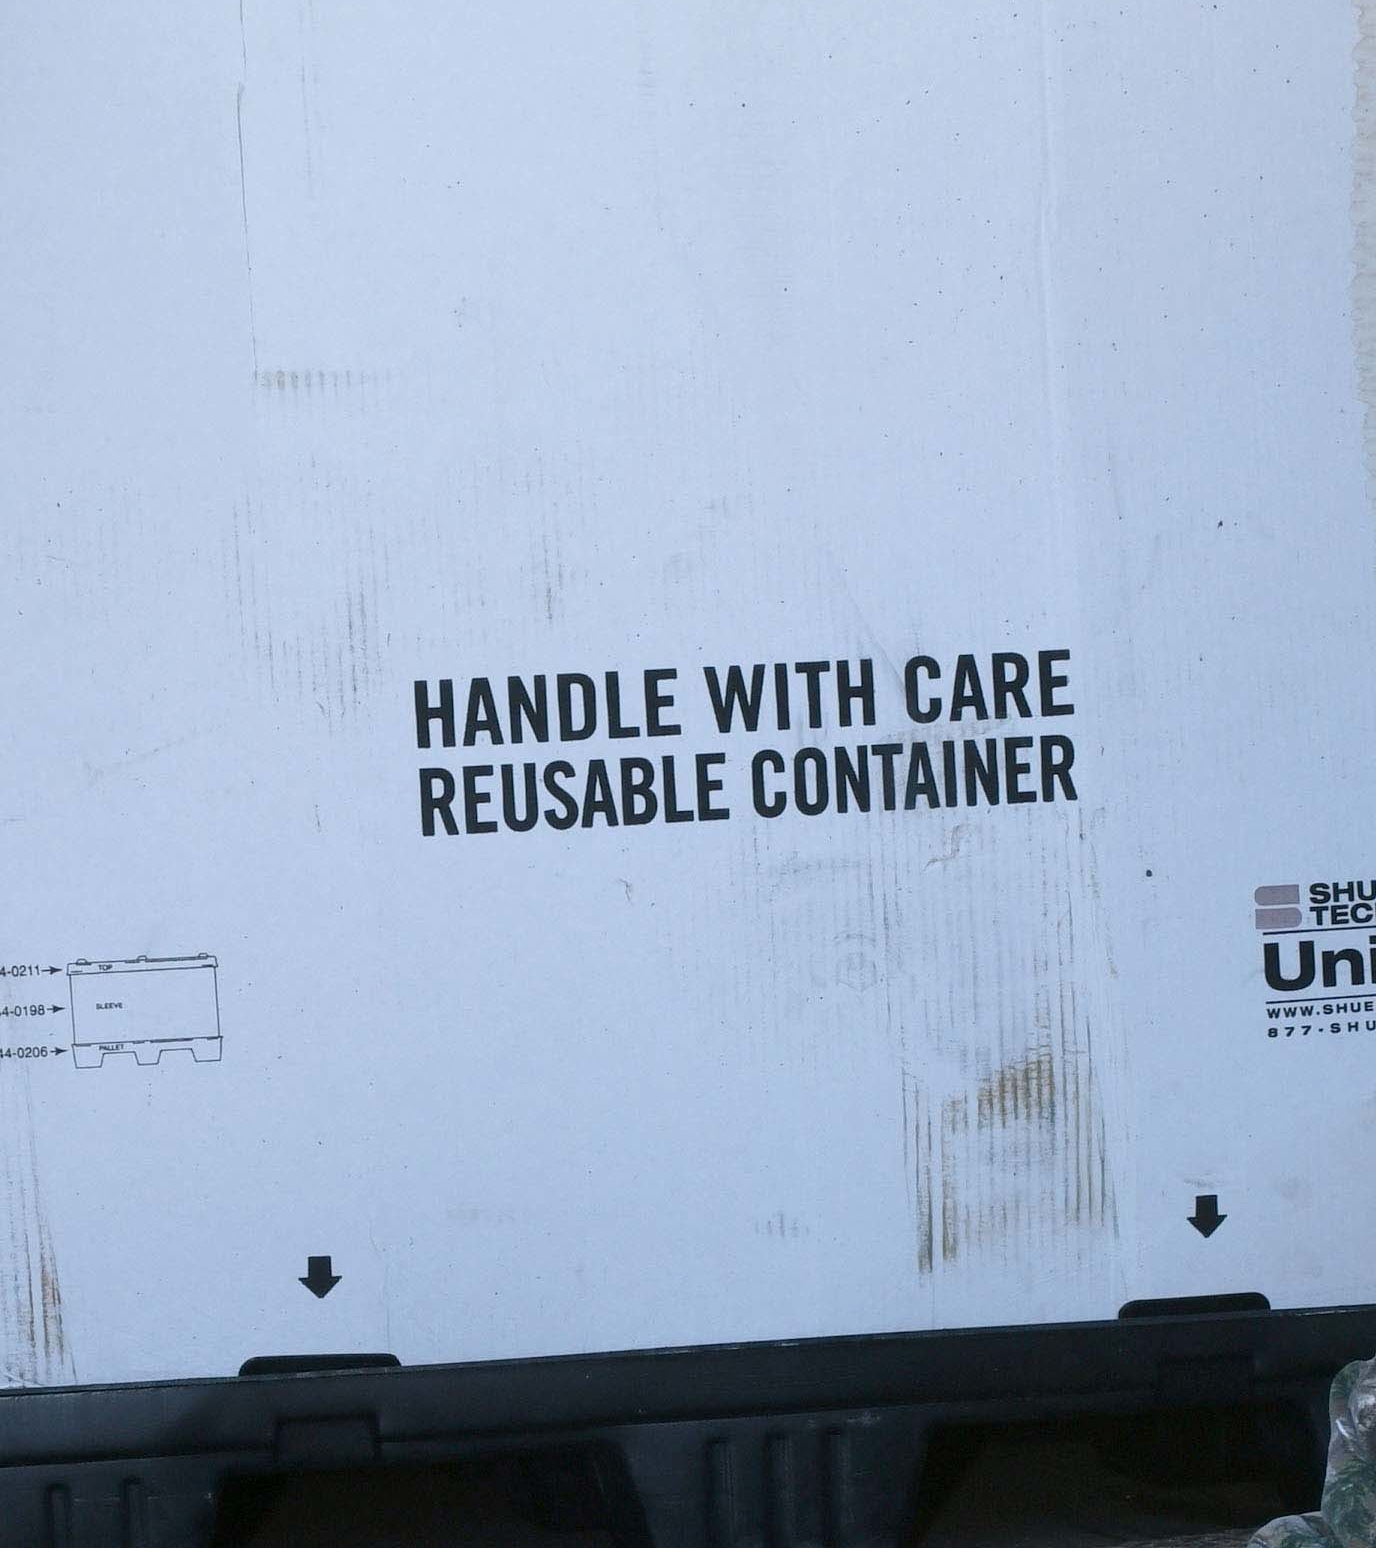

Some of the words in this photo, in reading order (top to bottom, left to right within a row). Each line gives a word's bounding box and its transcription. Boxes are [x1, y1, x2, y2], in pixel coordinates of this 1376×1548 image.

[413, 667, 682, 749] HANDLE
[702, 657, 877, 734] WITH
[904, 648, 1075, 725] CARE
[418, 752, 731, 837] REUSABLE
[751, 734, 1079, 819] CONTAINER
[97, 963, 113, 972] TOP
[95, 1002, 124, 1011] SLEEVE
[98, 1043, 124, 1052] PALLET
